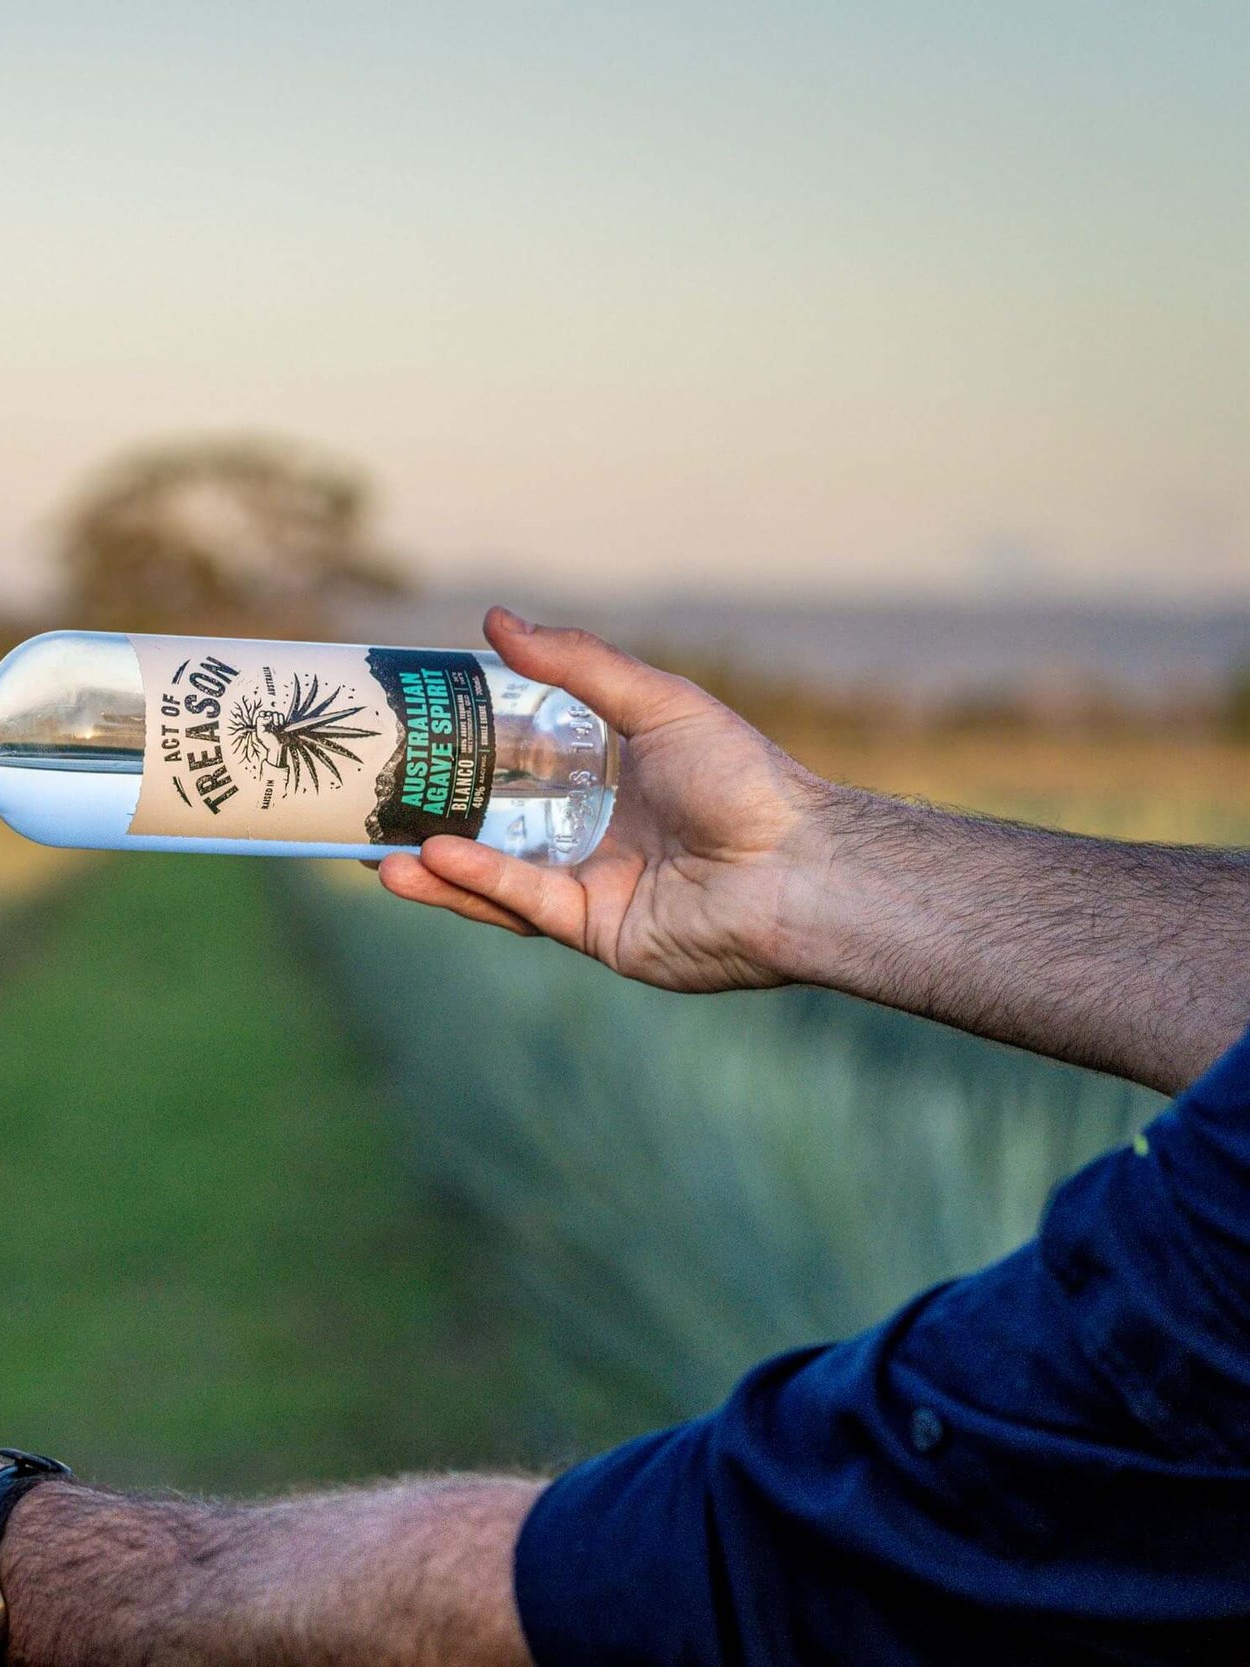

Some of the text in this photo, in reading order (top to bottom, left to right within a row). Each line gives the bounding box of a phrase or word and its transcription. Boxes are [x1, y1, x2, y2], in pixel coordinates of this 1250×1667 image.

[262, 666, 276, 697] AUSTRALIA
[161, 694, 182, 762] ACT OF
[184, 656, 240, 815] TREASON
[399, 672, 430, 807] AUSTRALIAN
[421, 667, 453, 815] AGAVE SPIRIT
[261, 786, 273, 810] RAISED
[451, 759, 475, 811] BLANCO
[471, 786, 486, 809] 40%
